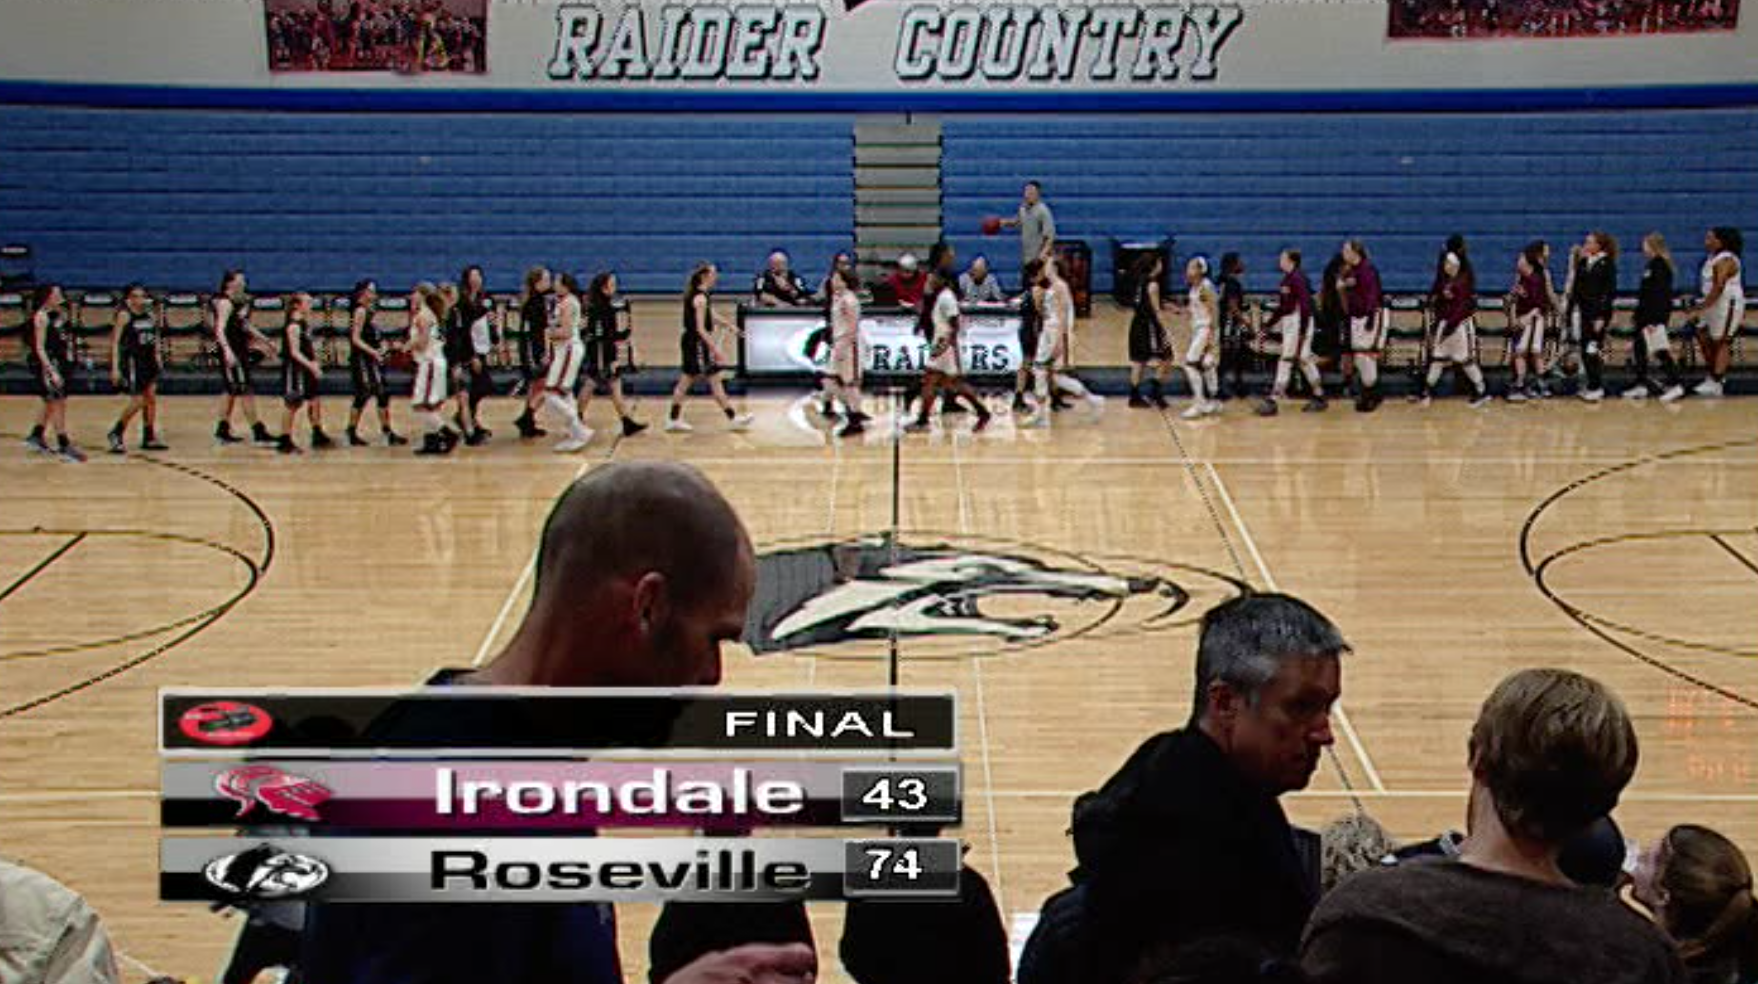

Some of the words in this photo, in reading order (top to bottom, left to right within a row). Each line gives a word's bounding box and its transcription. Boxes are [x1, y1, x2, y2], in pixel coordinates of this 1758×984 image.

[549, 4, 826, 79] RAIDER
[895, 4, 1243, 79] COUNTRY
[873, 344, 1009, 371] RAIRS
